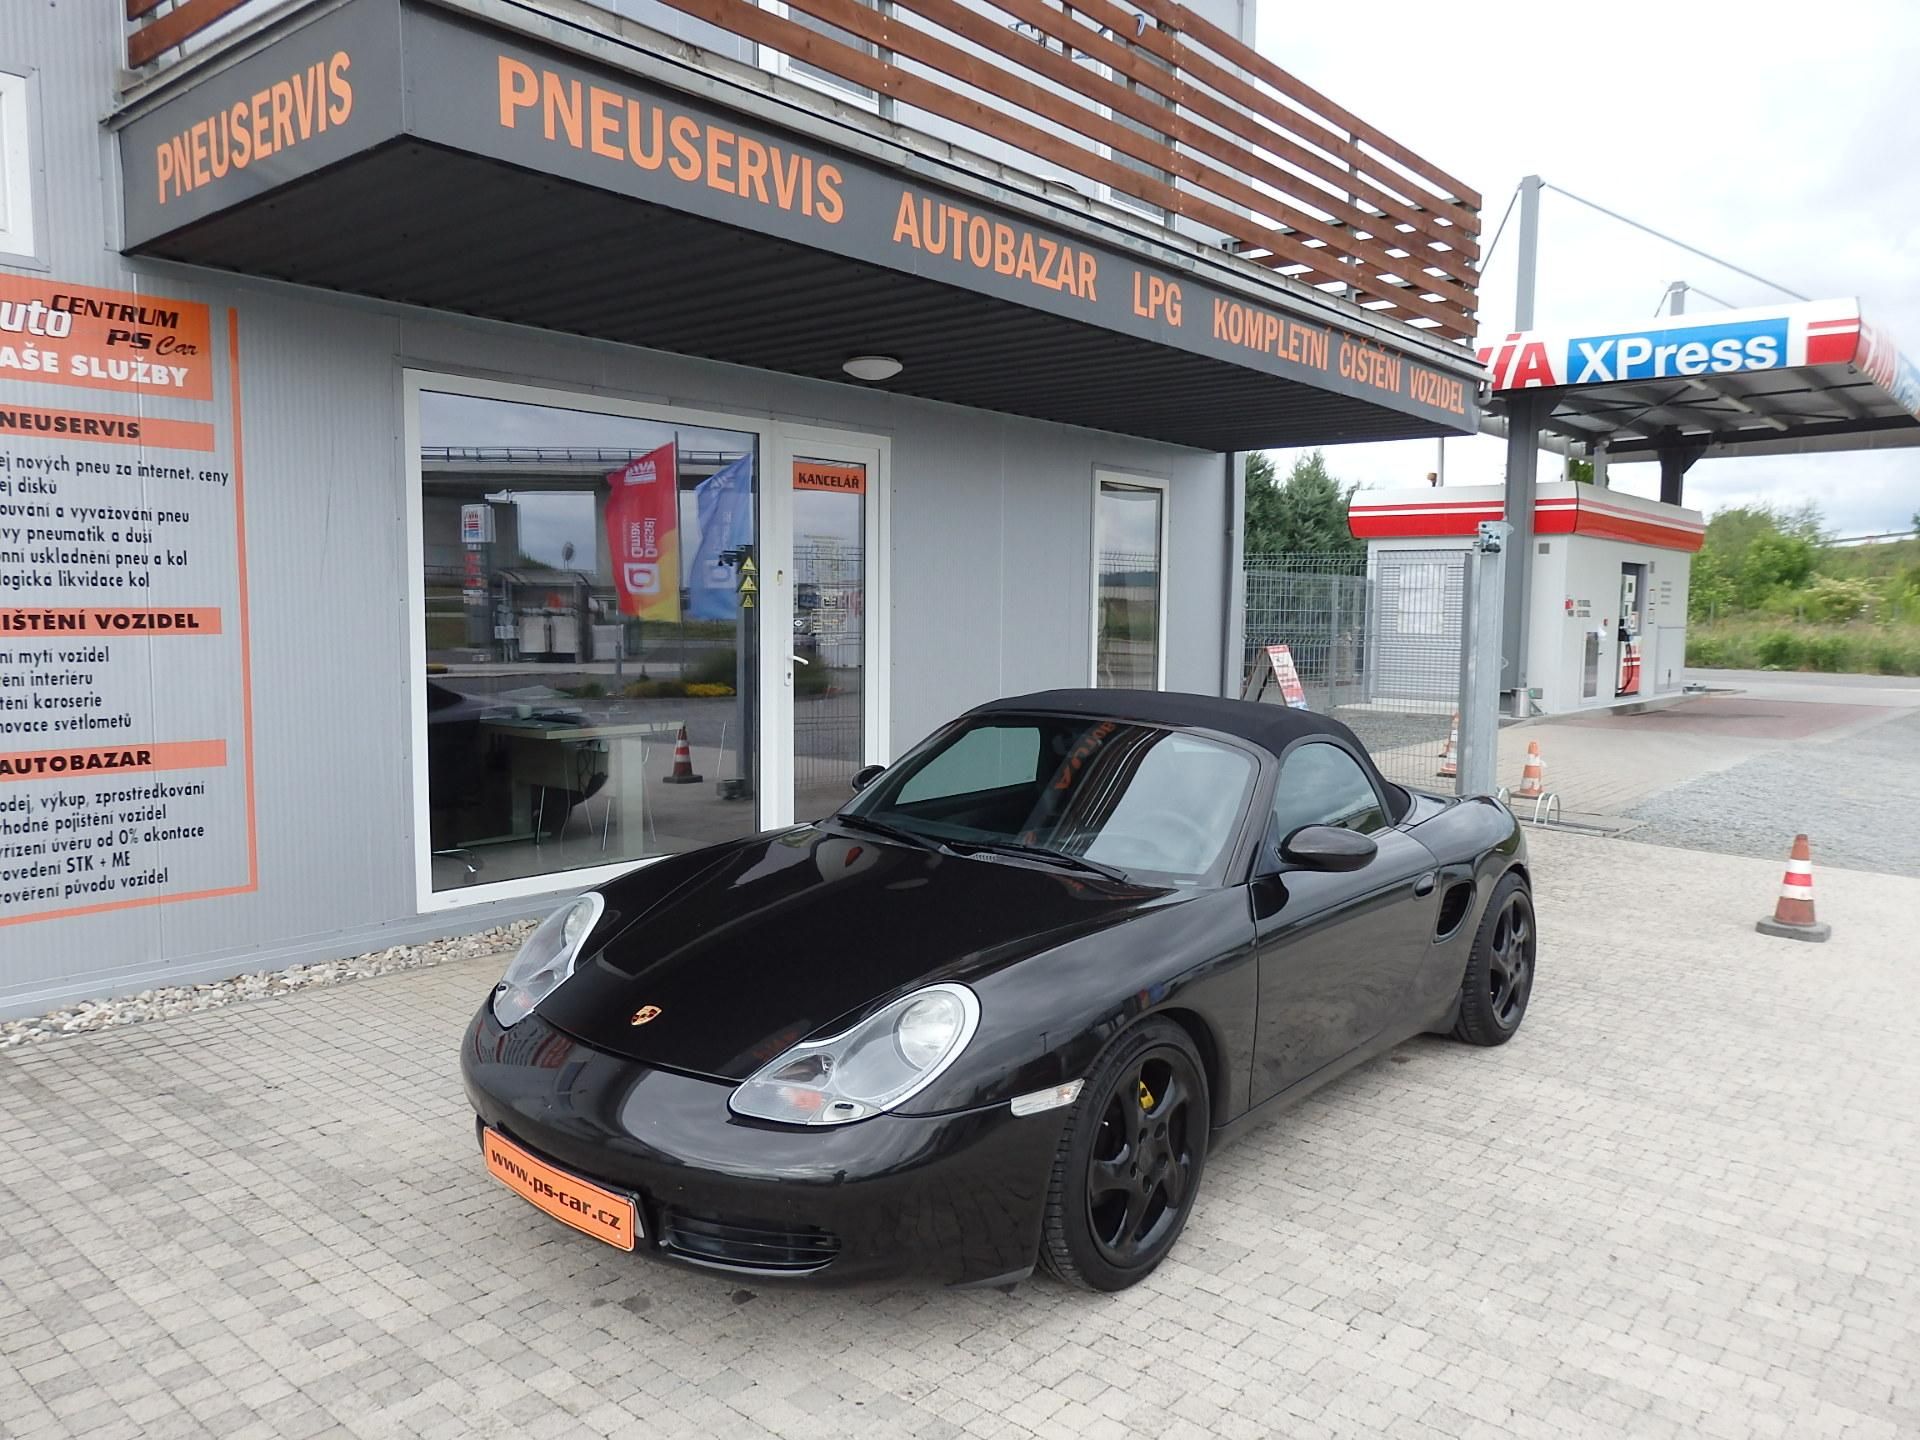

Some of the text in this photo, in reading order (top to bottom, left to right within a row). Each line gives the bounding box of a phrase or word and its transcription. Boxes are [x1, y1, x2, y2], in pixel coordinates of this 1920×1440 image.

[156, 50, 353, 205] PNEUSERVIS
[497, 55, 1465, 414] PNEUSERVIS AUTOBAZAR LPG KOMPLETNÍ ČIŠTĚNÍ VOZIDEL
[51, 294, 180, 329] CENTRUM
[107, 329, 199, 356] PS Car
[71, 355, 188, 387] SLUŽBY
[1575, 334, 1778, 383] XPress
[16, 455, 70, 475] nových
[76, 461, 110, 477] pneu
[116, 463, 132, 476] za
[138, 461, 194, 481] internet.
[199, 470, 229, 487] ceny
[798, 472, 859, 489] KANCELÁŘ
[18, 475, 57, 494] disků
[56, 507, 64, 518] a
[70, 504, 153, 523] vyvažování
[158, 512, 190, 526] pneu
[0, 528, 21, 544] vy
[27, 526, 105, 544] pneumatik
[111, 532, 120, 543] a
[0, 546, 188, 568] nní uskladnění pneu a kol
[58, 570, 123, 588] likvidace
[128, 571, 150, 588] kol
[94, 613, 200, 630] VOZIDEL
[19, 648, 52, 668] mytí
[59, 646, 110, 664] vozidel
[0, 669, 93, 687] ění interiéru
[33, 691, 102, 709] karoserie
[54, 712, 132, 732] světlometů
[0, 750, 152, 776] AUTOBAZAR
[95, 780, 205, 806] zprostředkování
[118, 804, 167, 823] vozidel
[52, 834, 92, 853] úvěru
[97, 831, 113, 848] od
[119, 828, 139, 845] 0%
[144, 826, 205, 843] akontace
[0, 860, 61, 881] ovedení
[66, 855, 93, 874] STK
[112, 851, 131, 868] ME
[65, 874, 115, 900] původu
[121, 867, 169, 888] vozidel
[491, 1149, 621, 1231] www.ps-car.cz
